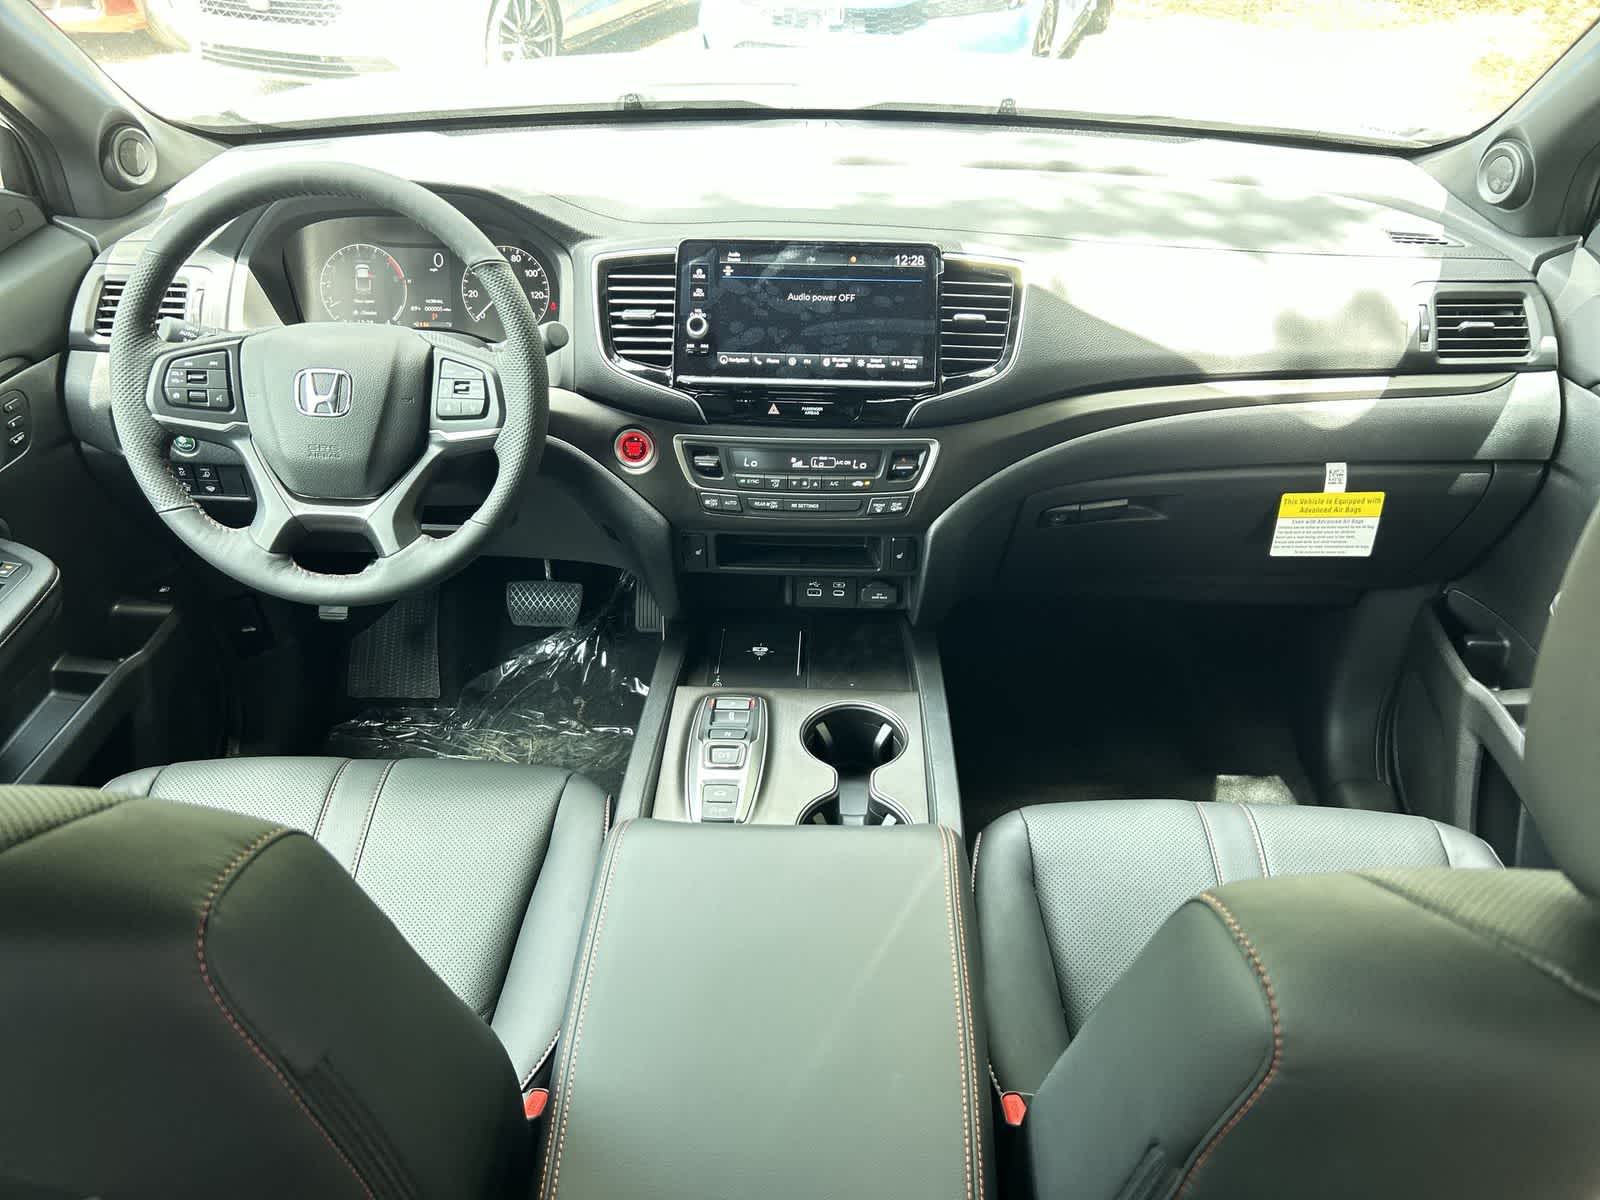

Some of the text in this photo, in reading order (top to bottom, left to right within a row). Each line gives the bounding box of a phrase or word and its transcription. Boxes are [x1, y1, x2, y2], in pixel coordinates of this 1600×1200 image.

[433, 252, 444, 268] 0
[894, 255, 925, 266] 12:28
[524, 269, 538, 277] 100
[467, 290, 478, 298] 20
[530, 291, 544, 299] 120
[787, 292, 856, 303] Audio power OFF
[743, 457, 758, 468] Lo
[852, 459, 867, 469] Lo
[1334, 498, 1366, 506] Equipped
[1345, 506, 1362, 514] Bags
